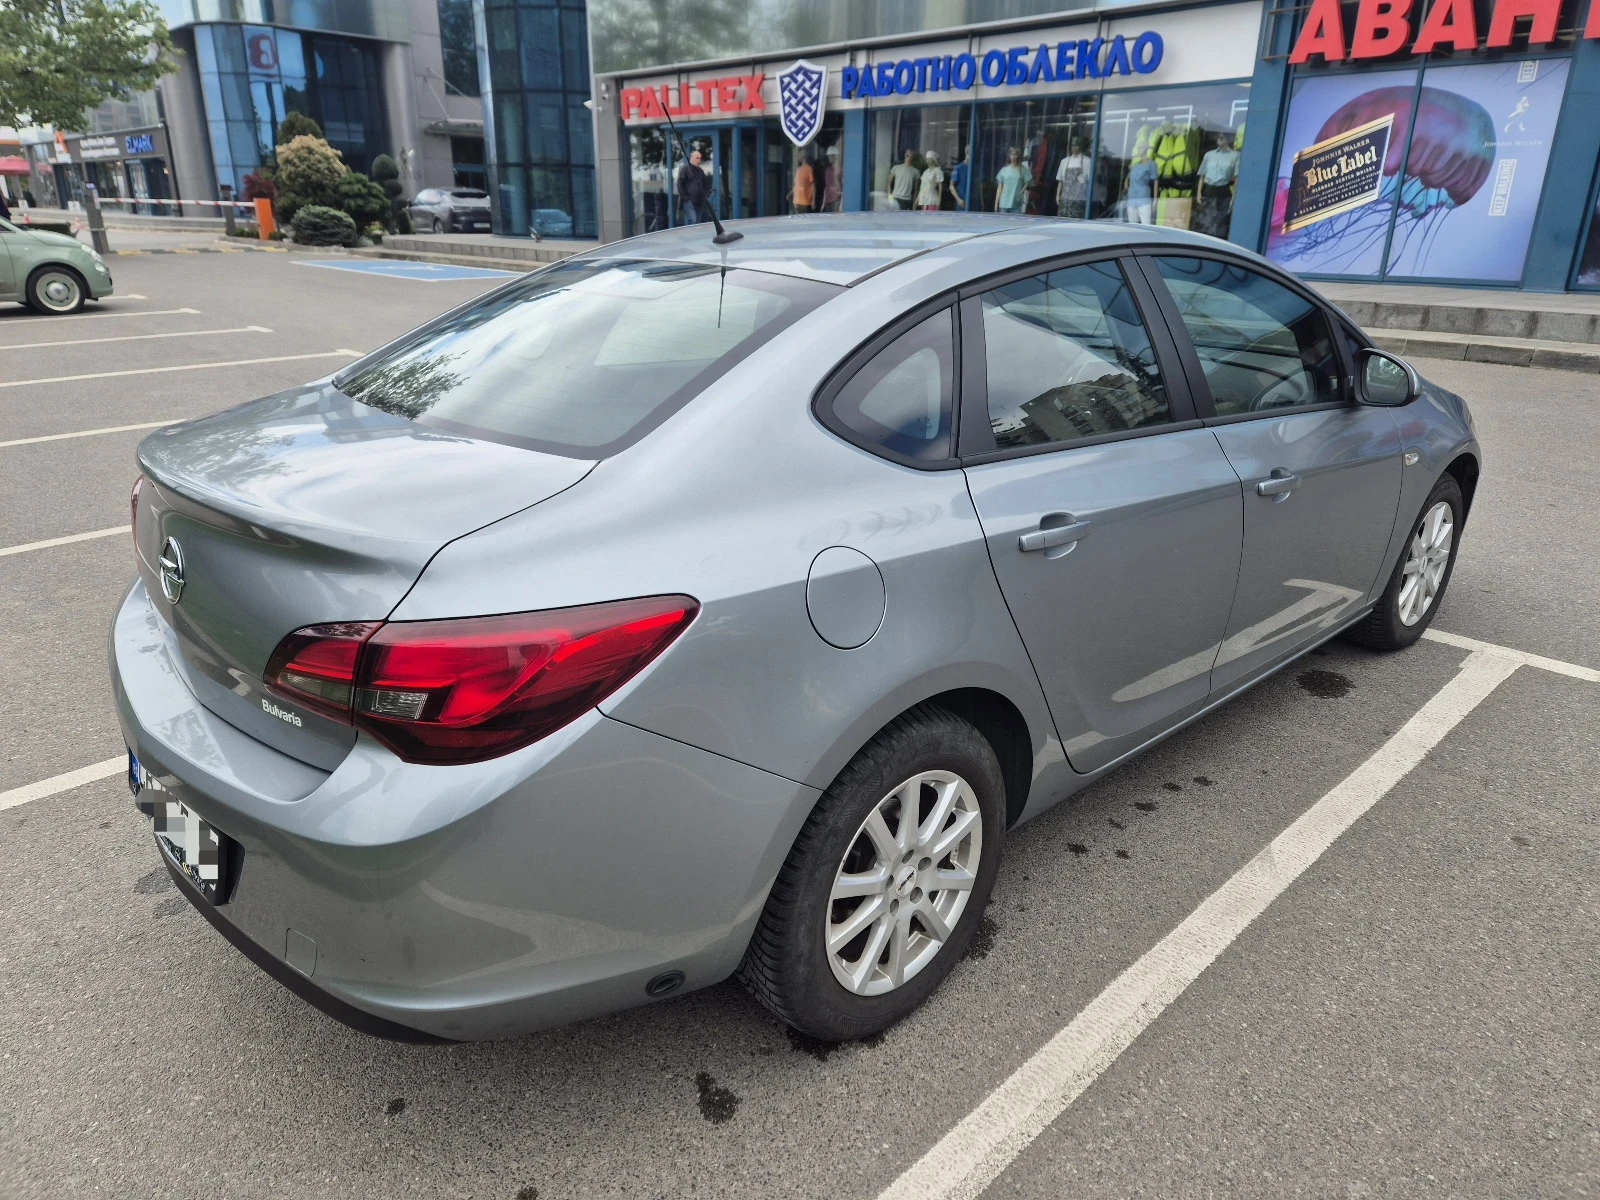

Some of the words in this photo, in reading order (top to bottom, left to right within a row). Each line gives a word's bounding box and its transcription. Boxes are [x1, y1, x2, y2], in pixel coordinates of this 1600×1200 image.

[1288, 0, 1600, 64] АВАН
[841, 52, 976, 99] РАБОТНО
[981, 31, 1164, 88] ОБЛЕКЛО
[621, 73, 766, 120] PALLTEX
[1304, 165, 1339, 189] Blue
[1337, 145, 1378, 176] Label
[1312, 148, 1342, 167] JOHNNIE
[1342, 138, 1371, 153] WALKER
[1496, 160, 1513, 196] WALKING
[1492, 195, 1506, 214] KEEP
[262, 699, 302, 728] Bulvaria
